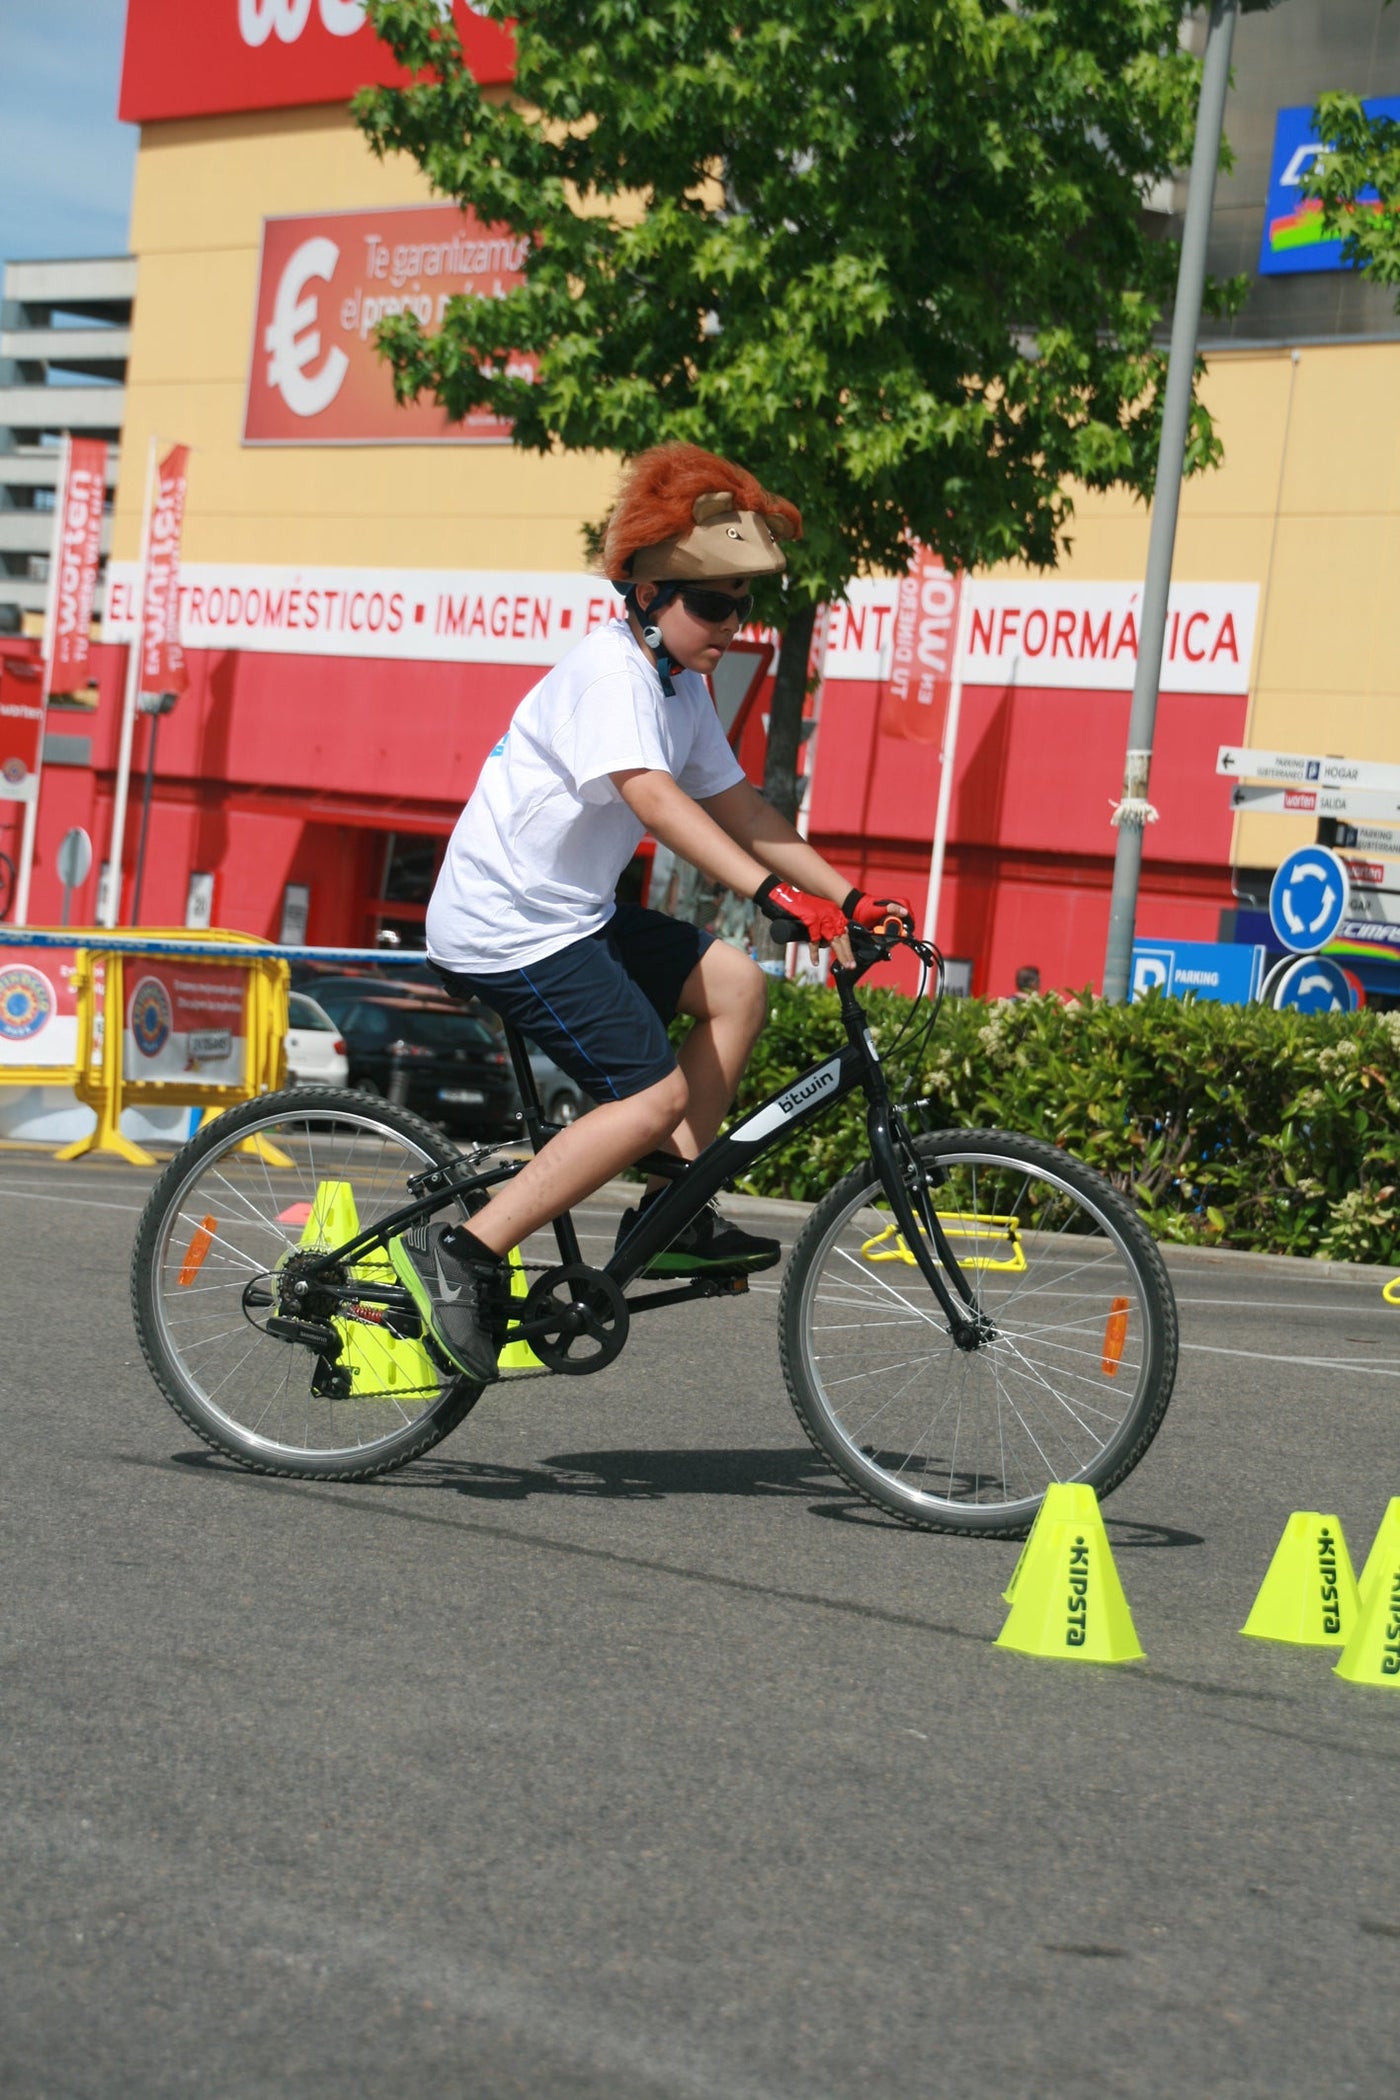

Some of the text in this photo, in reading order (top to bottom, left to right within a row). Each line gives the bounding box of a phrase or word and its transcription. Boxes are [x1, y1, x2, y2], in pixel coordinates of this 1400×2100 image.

[364, 234, 390, 279] Te
[435, 594, 552, 639] IMAGEN
[1324, 768, 1359, 781] HOGAR
[1321, 799, 1347, 810] SALIDA
[1175, 970, 1219, 986] PARKING
